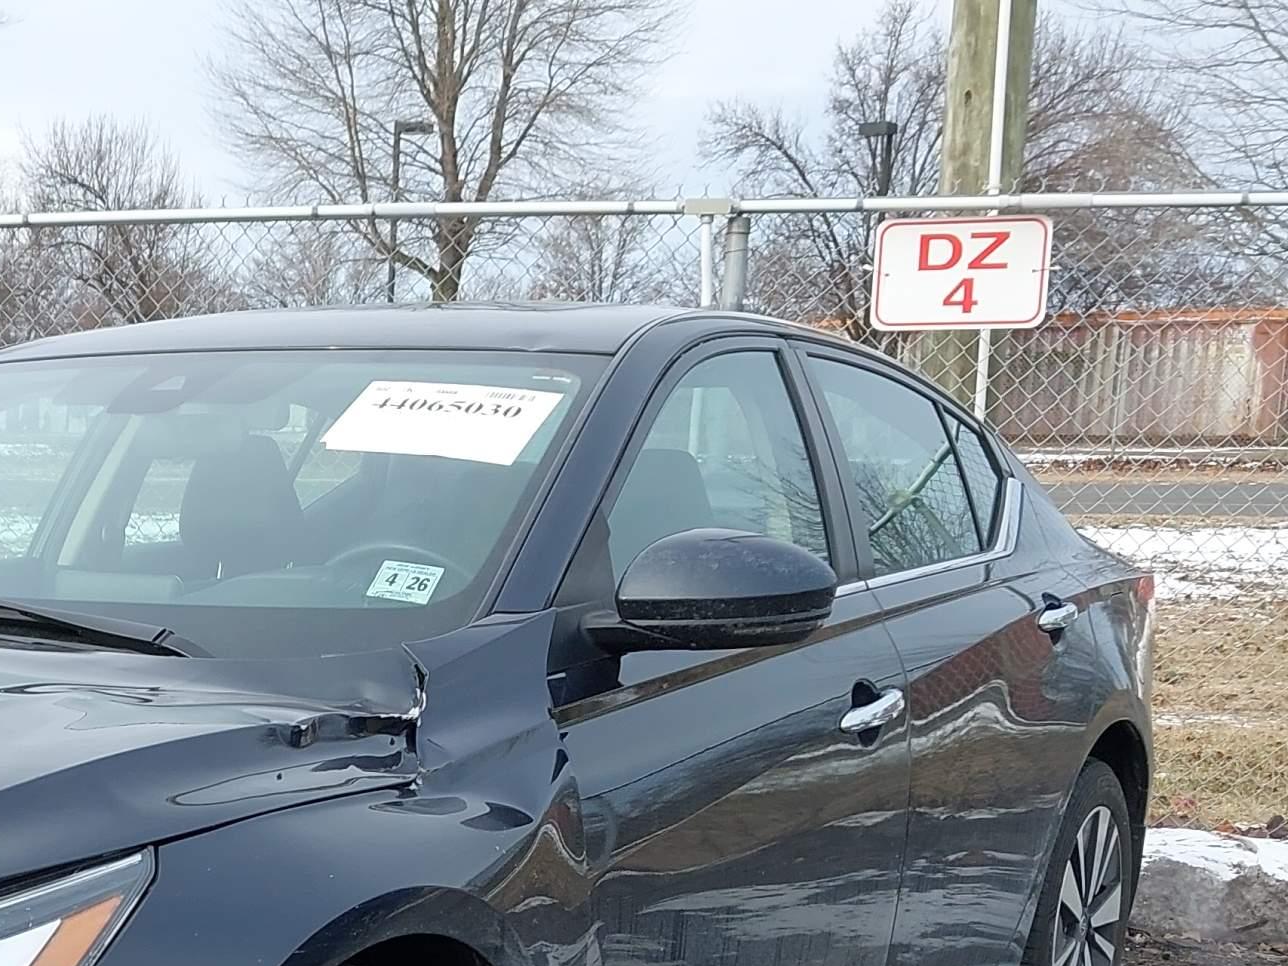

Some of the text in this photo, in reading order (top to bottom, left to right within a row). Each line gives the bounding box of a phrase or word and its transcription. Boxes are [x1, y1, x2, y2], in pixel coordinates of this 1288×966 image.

[918, 231, 1010, 271] DZ
[942, 277, 978, 314] 4
[371, 396, 523, 418] 44065030
[385, 573, 430, 591] 4 26
